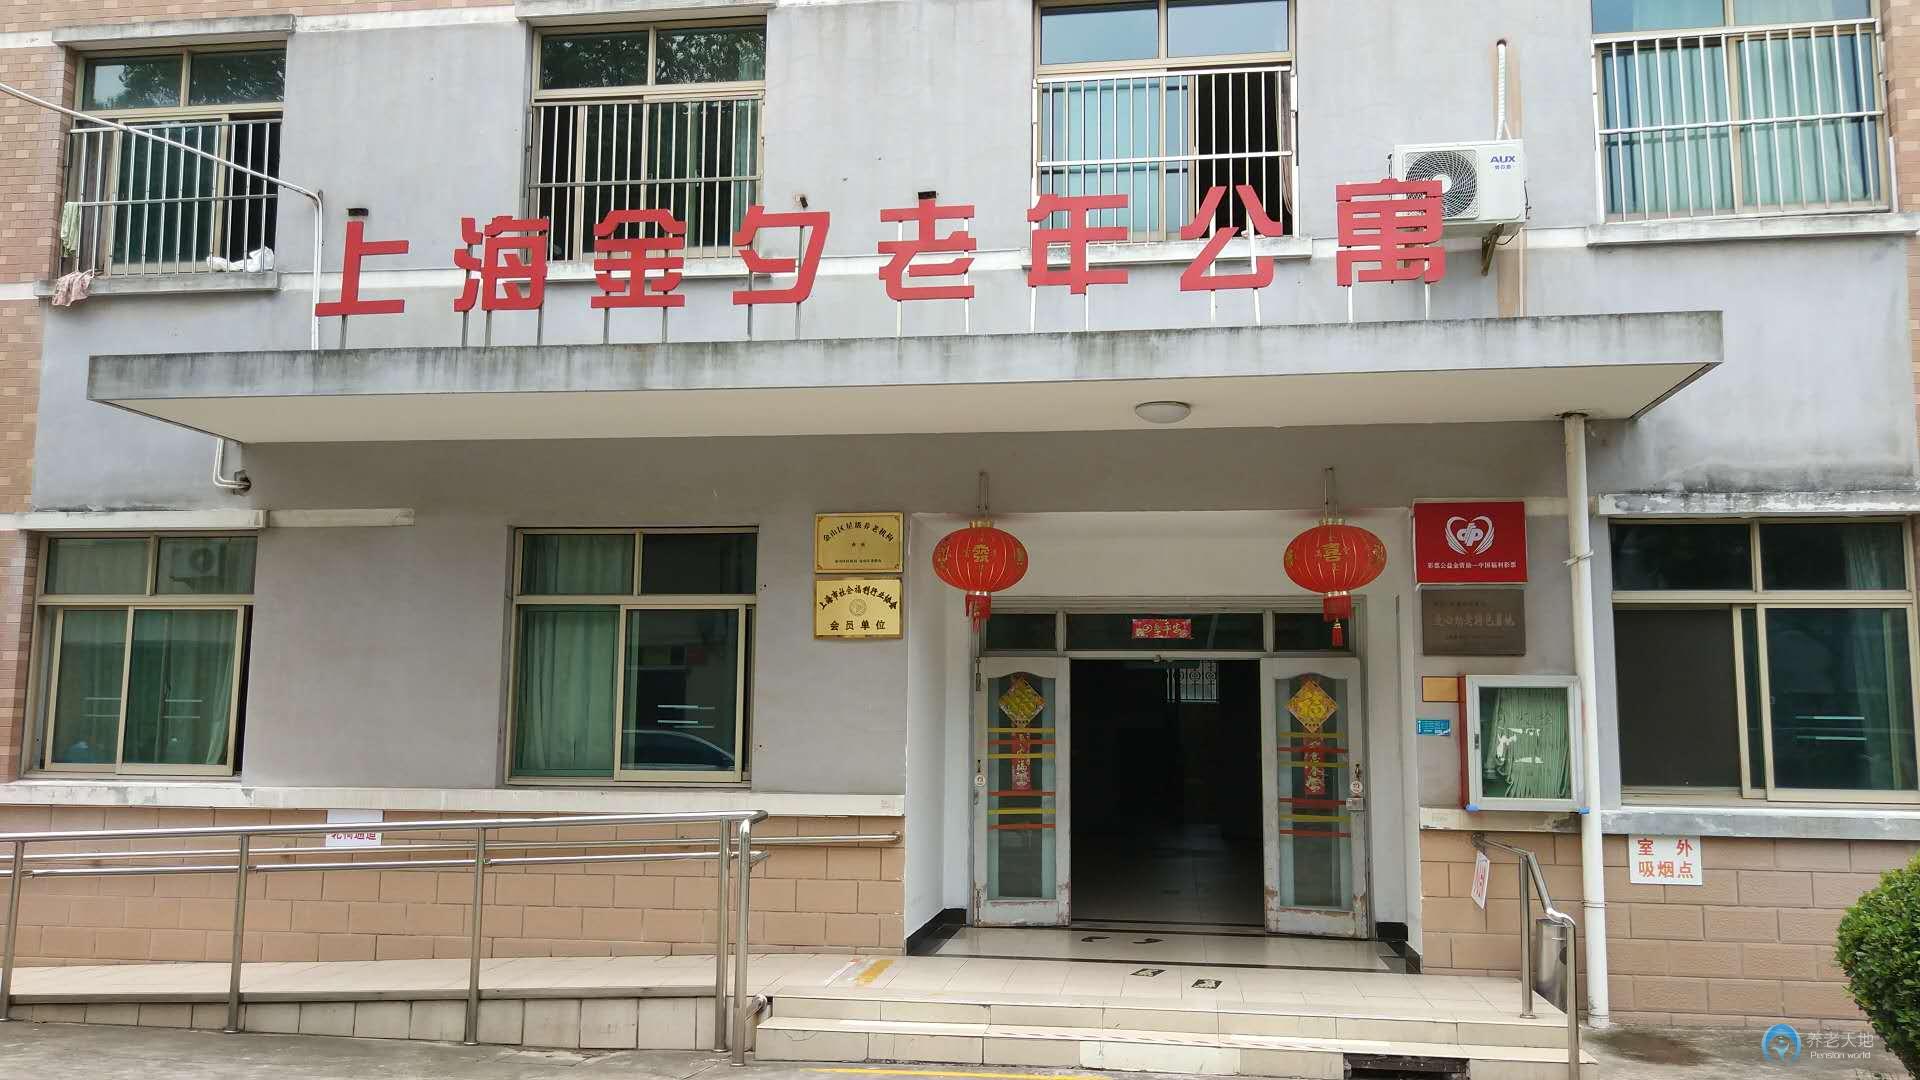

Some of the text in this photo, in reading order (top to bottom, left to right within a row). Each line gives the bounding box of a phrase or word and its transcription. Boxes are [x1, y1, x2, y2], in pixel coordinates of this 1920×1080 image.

[1490, 155, 1516, 163] AUX
[316, 180, 1446, 317] 上海金夕老年公寓
[819, 584, 898, 610] 上海市社会福利行业协会
[830, 620, 886, 631] 会员单位
[1638, 861, 1694, 878] 吸烟点
